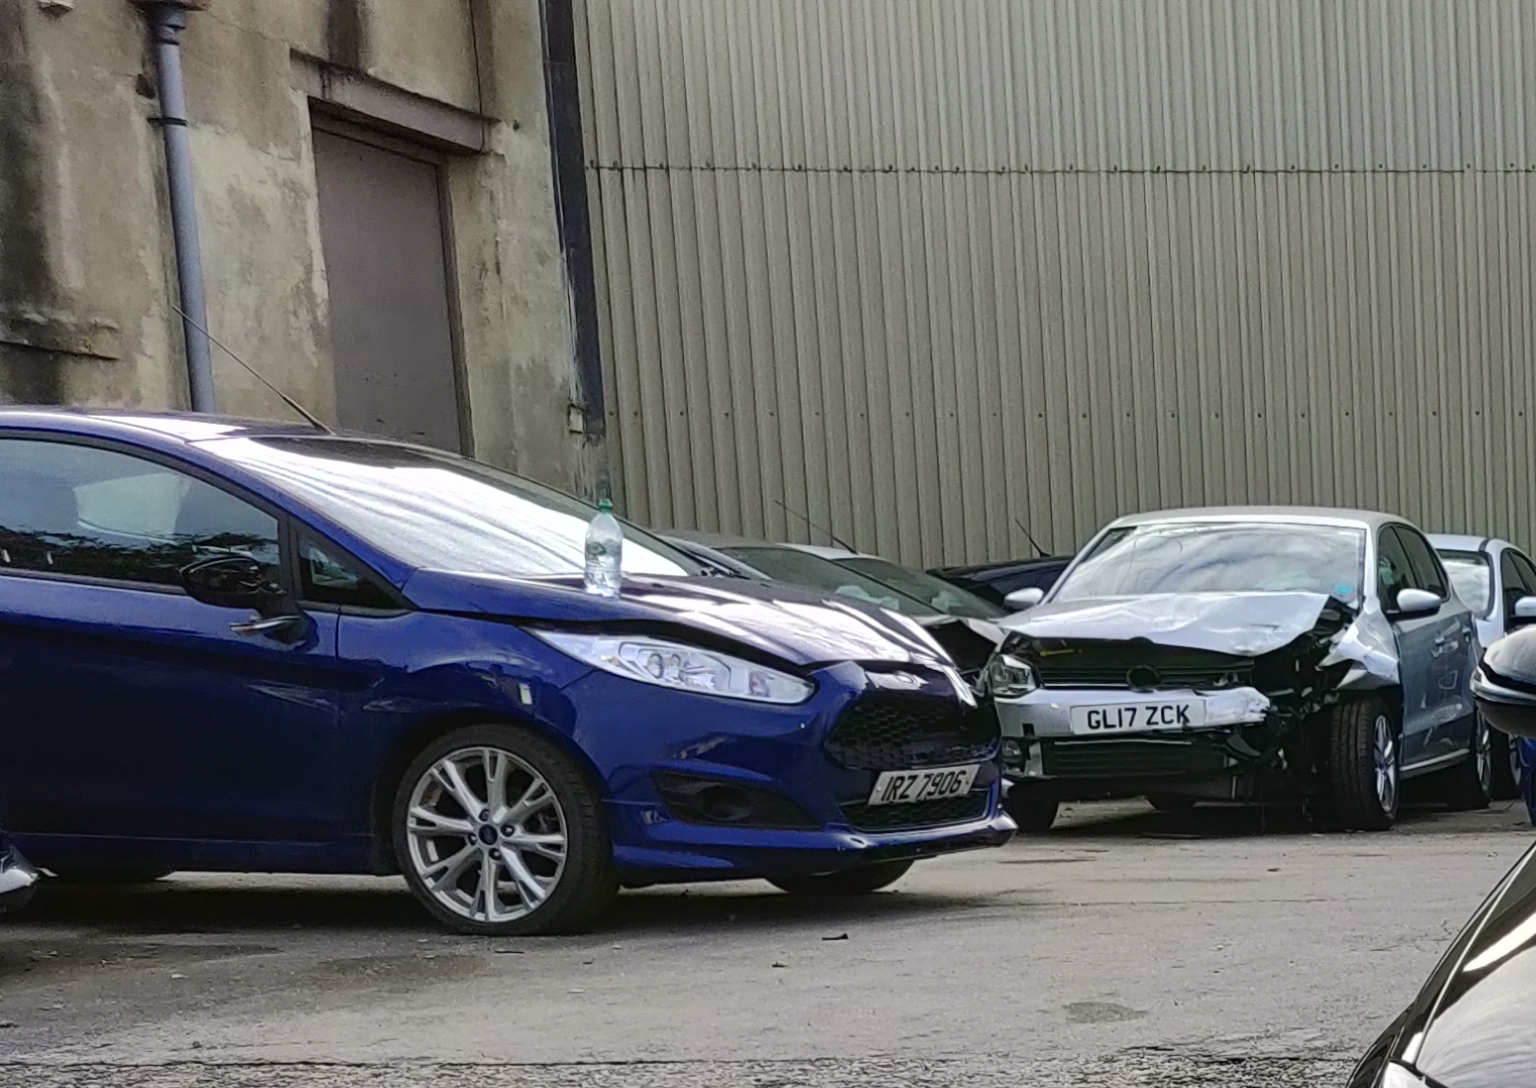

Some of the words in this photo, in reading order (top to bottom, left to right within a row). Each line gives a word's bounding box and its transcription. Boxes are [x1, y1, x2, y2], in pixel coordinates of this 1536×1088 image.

[1087, 706, 1138, 730] GL17
[1145, 704, 1191, 727] ZCK
[881, 774, 918, 802] IRZ
[917, 770, 966, 800] 7906
